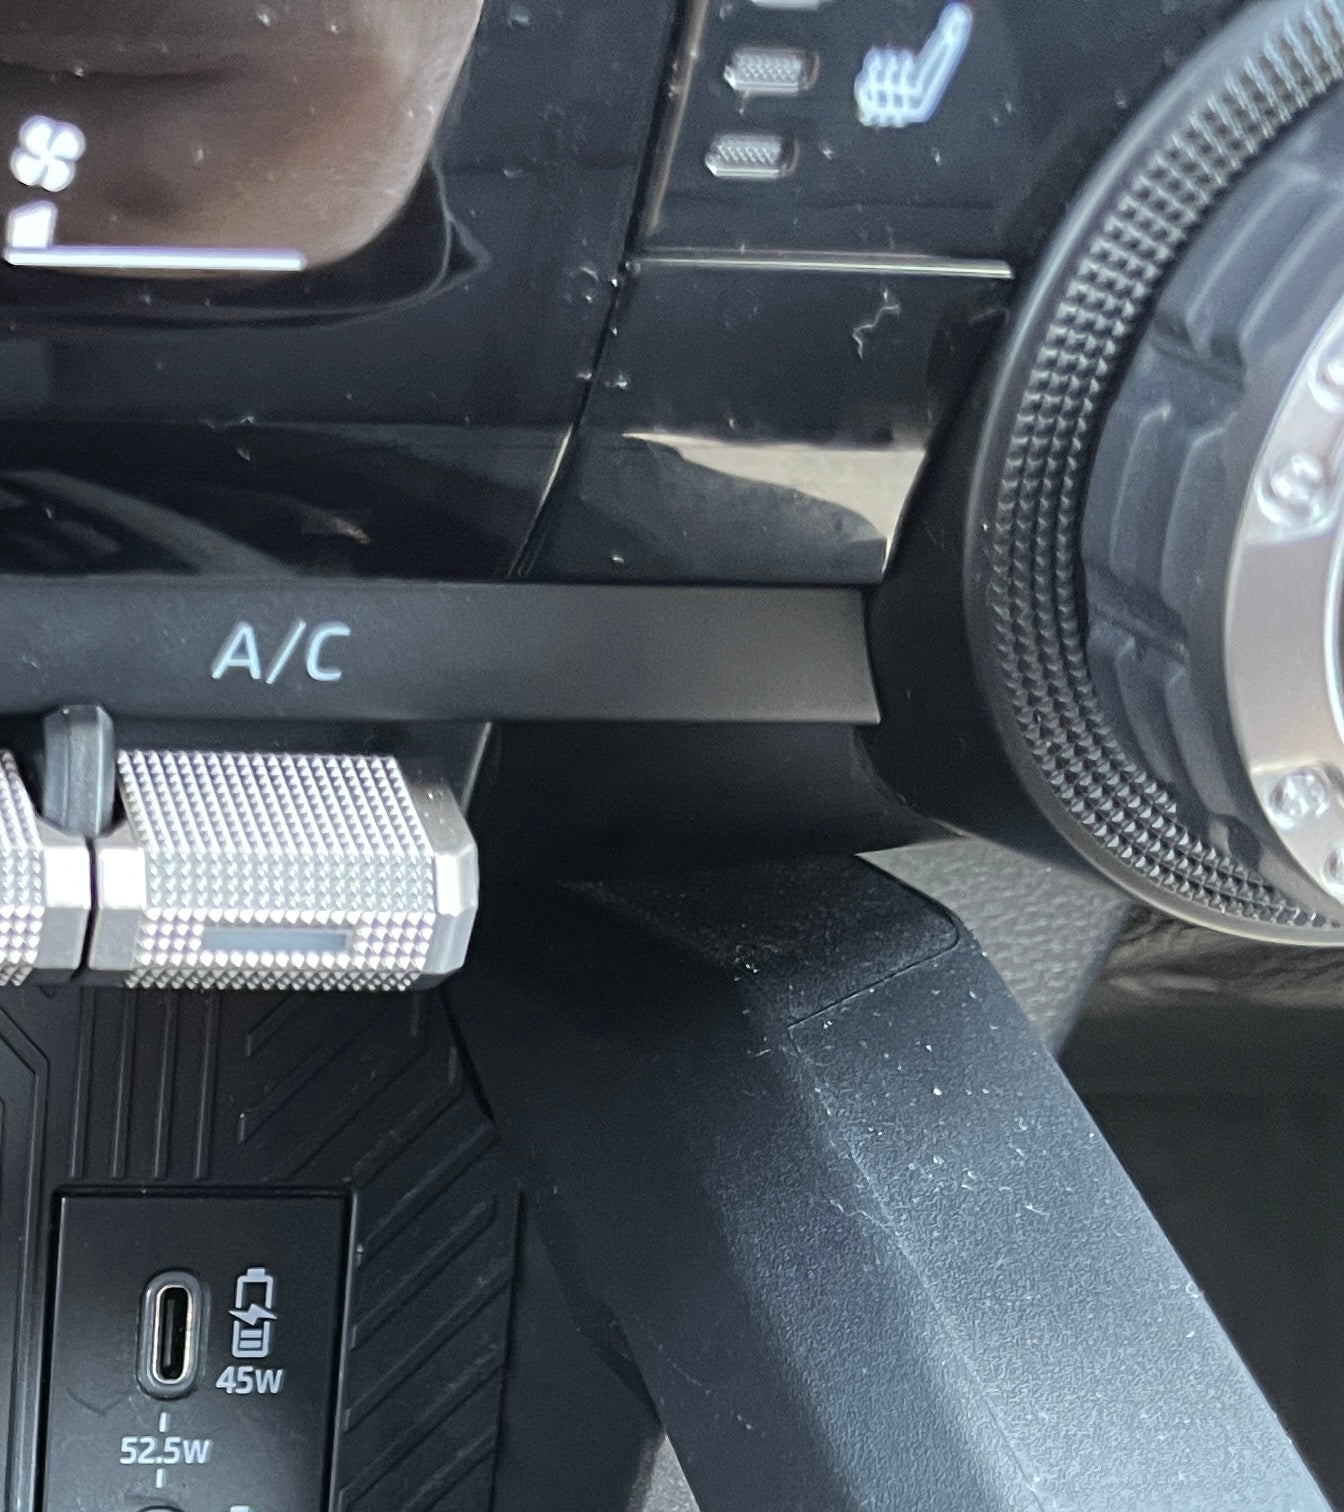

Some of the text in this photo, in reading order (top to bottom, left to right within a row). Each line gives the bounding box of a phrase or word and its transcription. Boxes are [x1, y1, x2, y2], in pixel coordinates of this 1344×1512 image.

[211, 617, 351, 684] A/C
[215, 1365, 283, 1394] 45W
[119, 1436, 211, 1465] 52.5W
